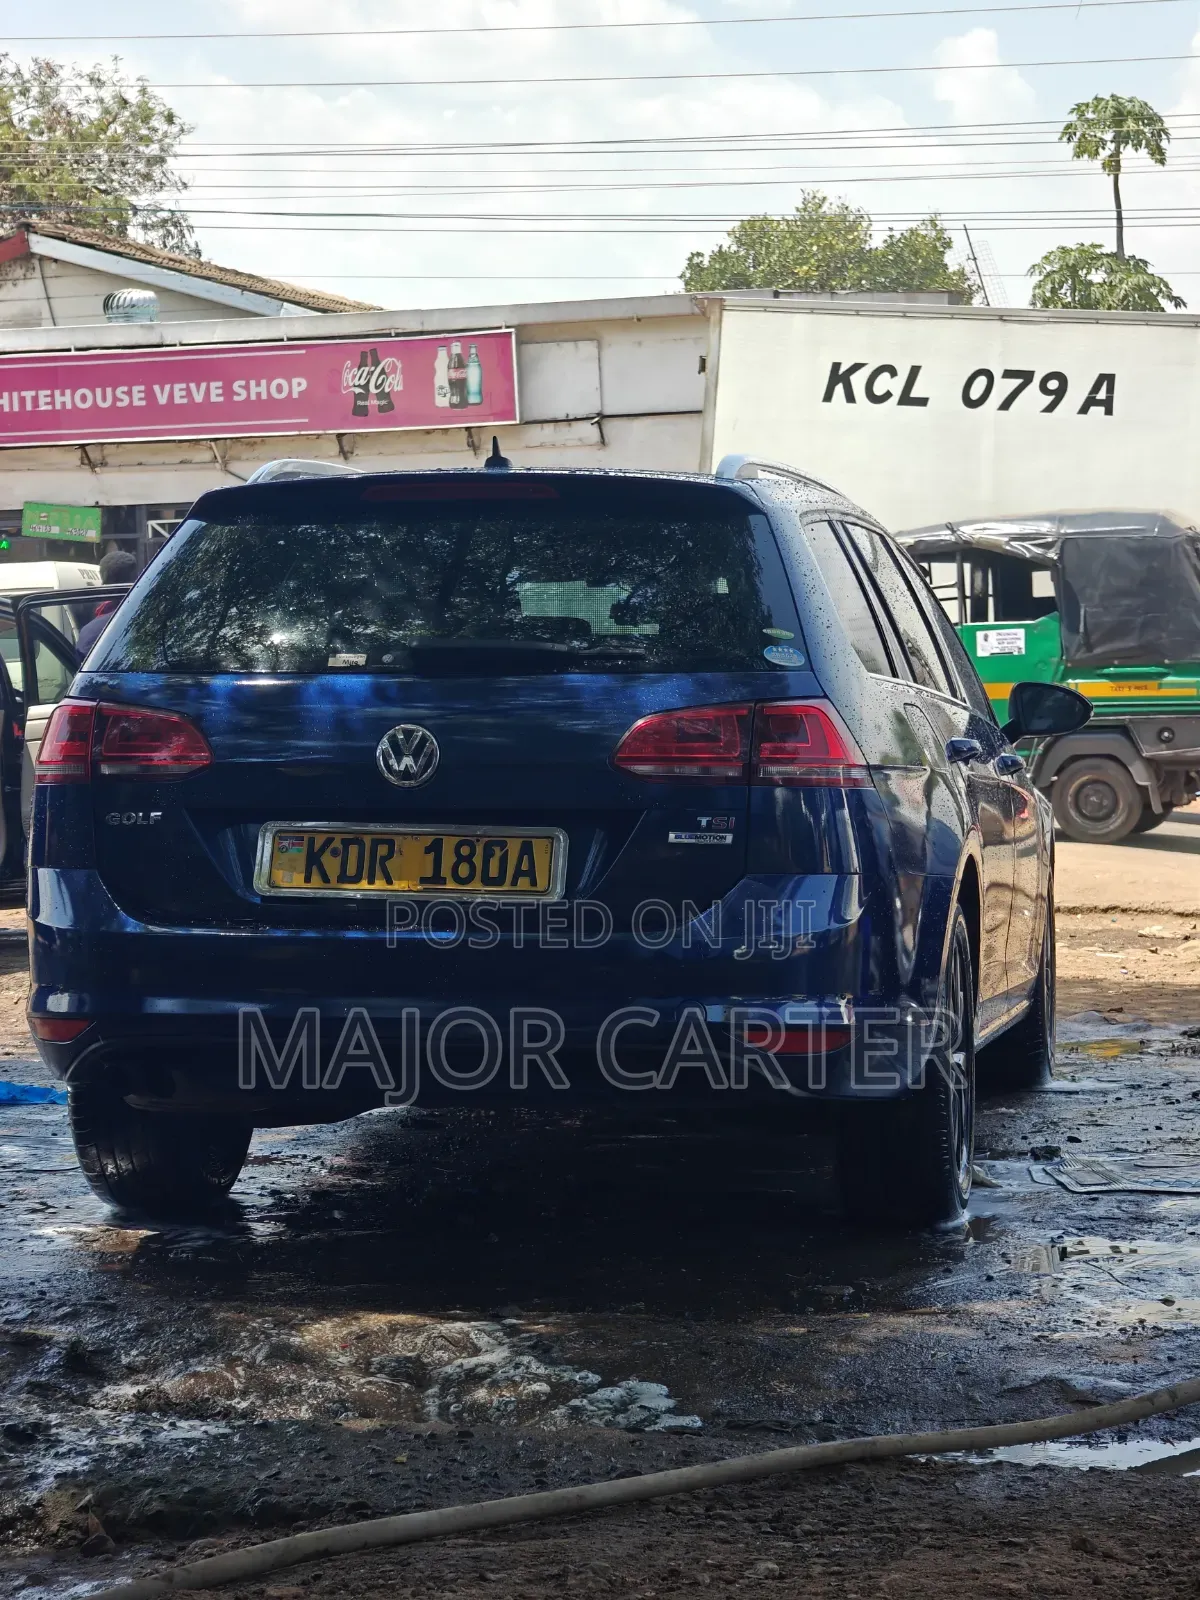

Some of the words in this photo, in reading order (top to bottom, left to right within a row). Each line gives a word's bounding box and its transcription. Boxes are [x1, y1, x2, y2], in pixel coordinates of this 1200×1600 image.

[153, 381, 224, 405] VEVE
[232, 377, 308, 402] SHOP
[821, 361, 931, 408] KCL
[961, 368, 1069, 413] 079
[1076, 372, 1117, 417] A
[105, 811, 163, 826] GOLF
[697, 816, 736, 830] TSI
[304, 836, 396, 886] KDR
[419, 837, 538, 887] 180A
